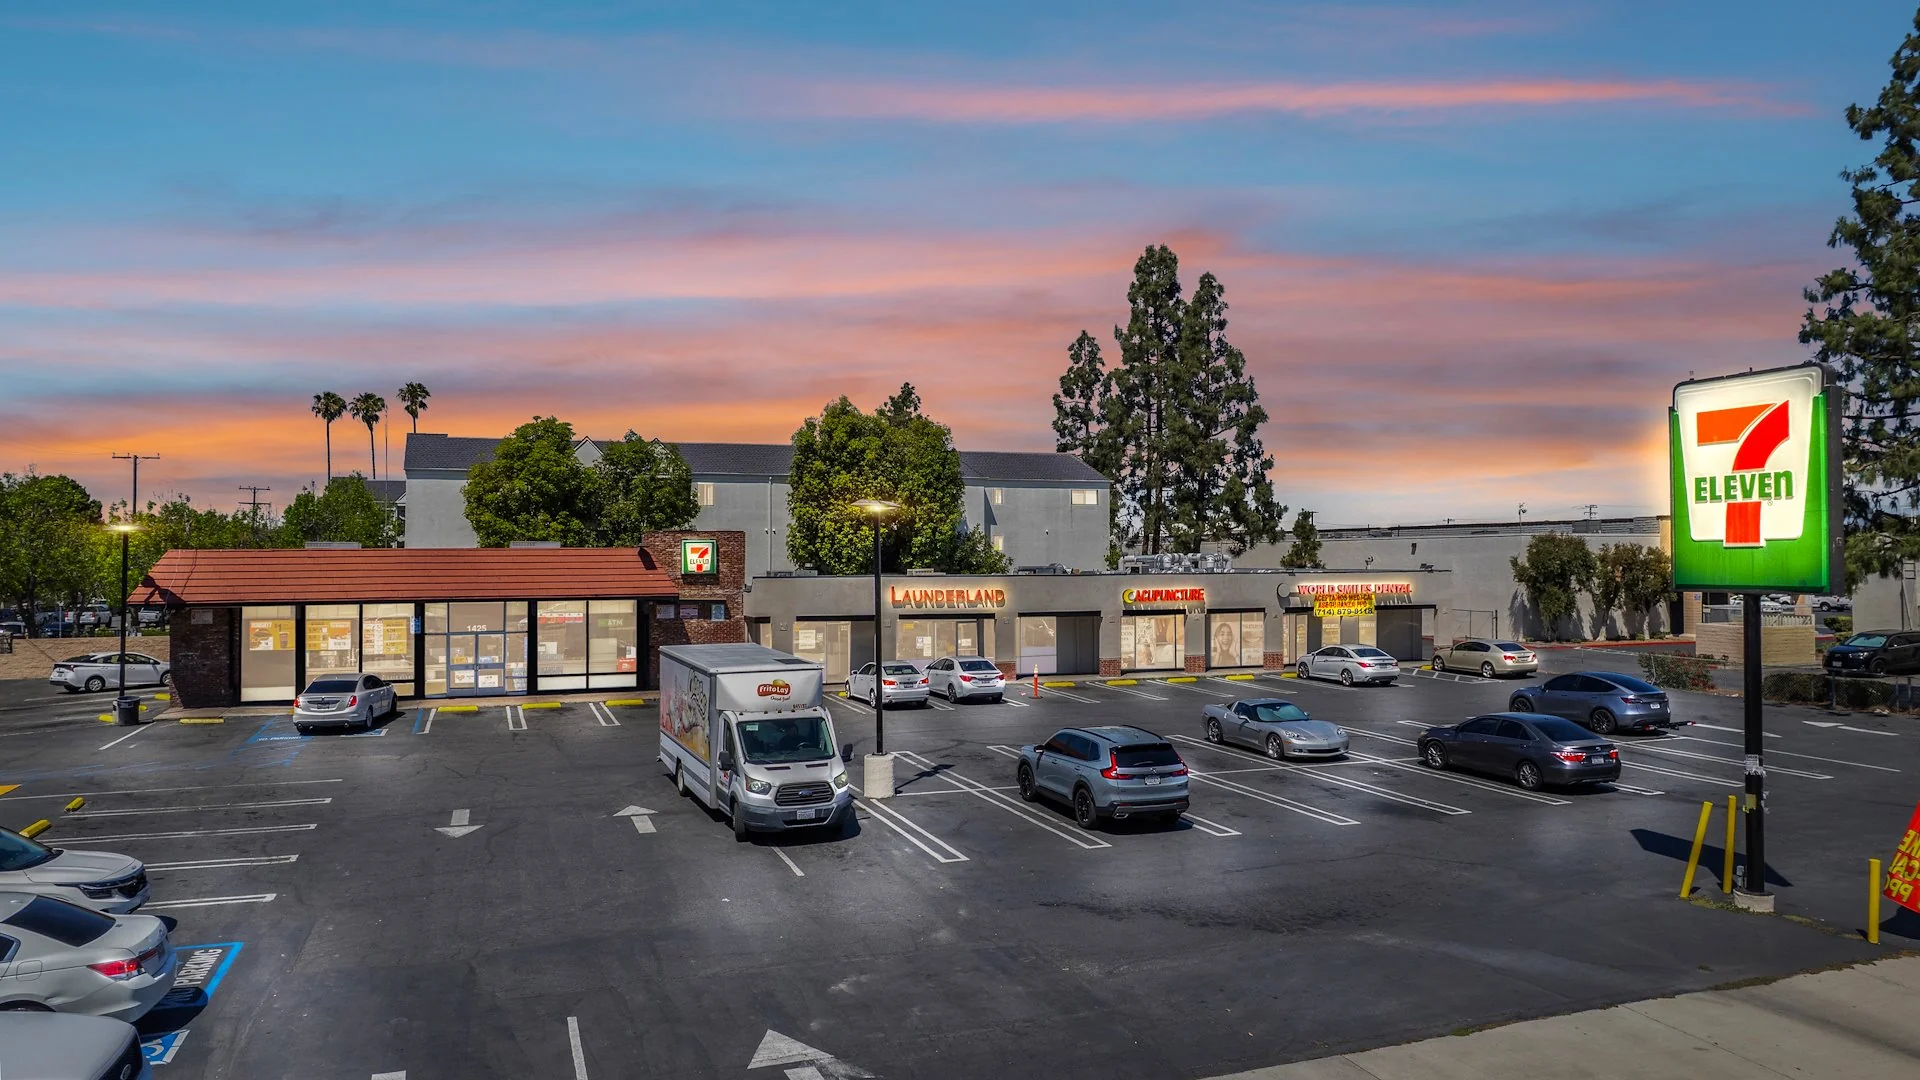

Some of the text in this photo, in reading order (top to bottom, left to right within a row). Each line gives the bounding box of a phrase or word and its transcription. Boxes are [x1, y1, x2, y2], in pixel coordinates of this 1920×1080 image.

[1696, 400, 1789, 544] 7
[690, 547, 709, 571] 7
[890, 585, 1006, 606] LAUNDERLAND
[1134, 588, 1205, 602] ACUPUNCTURE
[1297, 584, 1412, 594] WORLD SMILES DENTAL
[1314, 608, 1335, 616] (714)
[173, 948, 223, 987] PARKING
